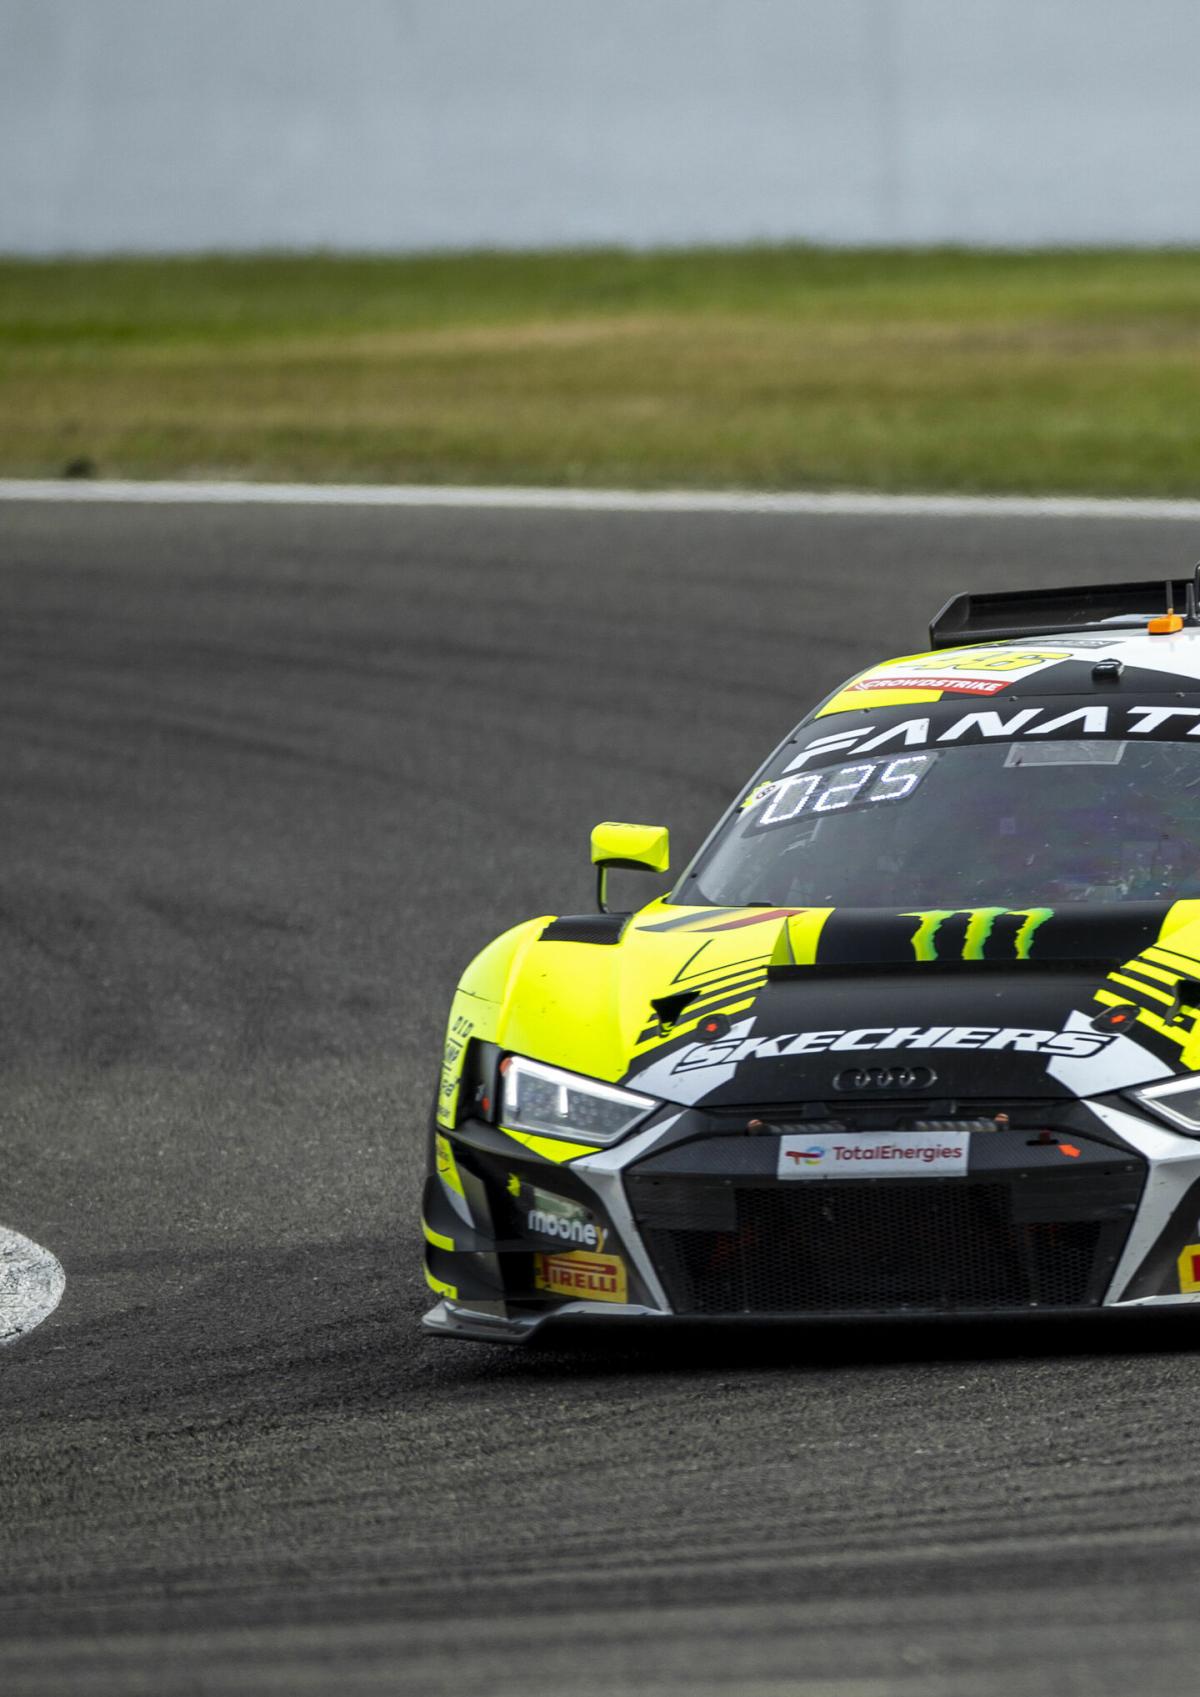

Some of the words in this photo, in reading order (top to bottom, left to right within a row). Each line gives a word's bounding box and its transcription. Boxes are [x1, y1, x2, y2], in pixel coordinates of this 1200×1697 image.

[865, 679, 1002, 692] CROWDSTRIKE
[670, 1026, 1121, 1075] SKECHERS
[833, 1143, 962, 1164] TotalEnergies
[528, 1210, 608, 1253] mooney
[542, 1255, 618, 1293] PIRELLI
